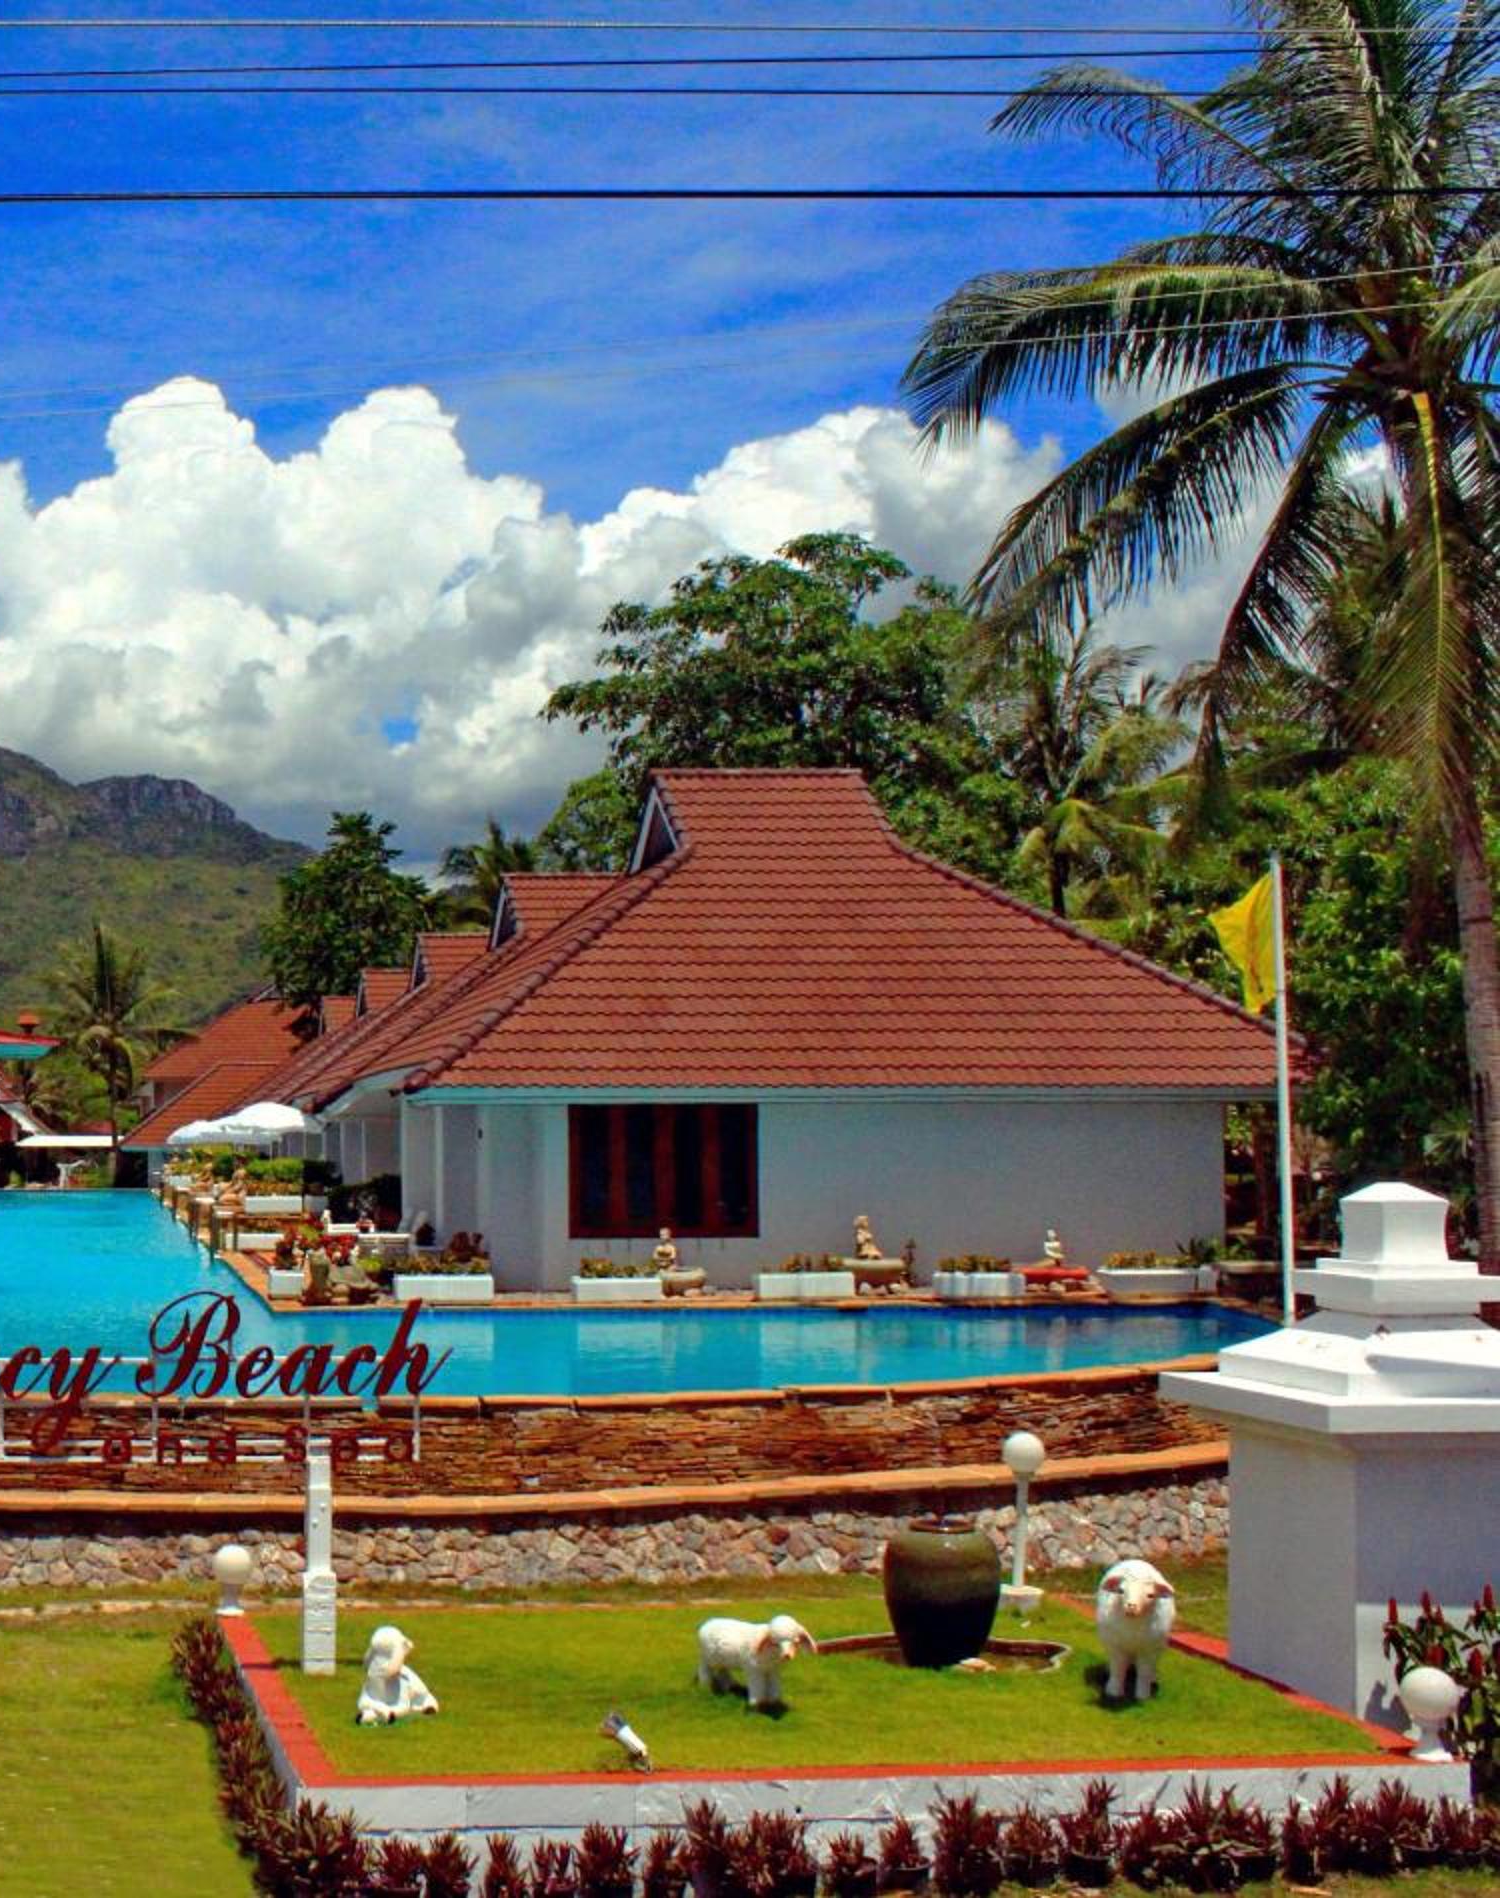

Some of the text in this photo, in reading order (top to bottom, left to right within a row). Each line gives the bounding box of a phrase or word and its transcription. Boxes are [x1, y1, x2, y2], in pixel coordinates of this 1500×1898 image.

[137, 1290, 453, 1398] Beach
[103, 1426, 237, 1464] and
[284, 1426, 416, 1471] Spa
